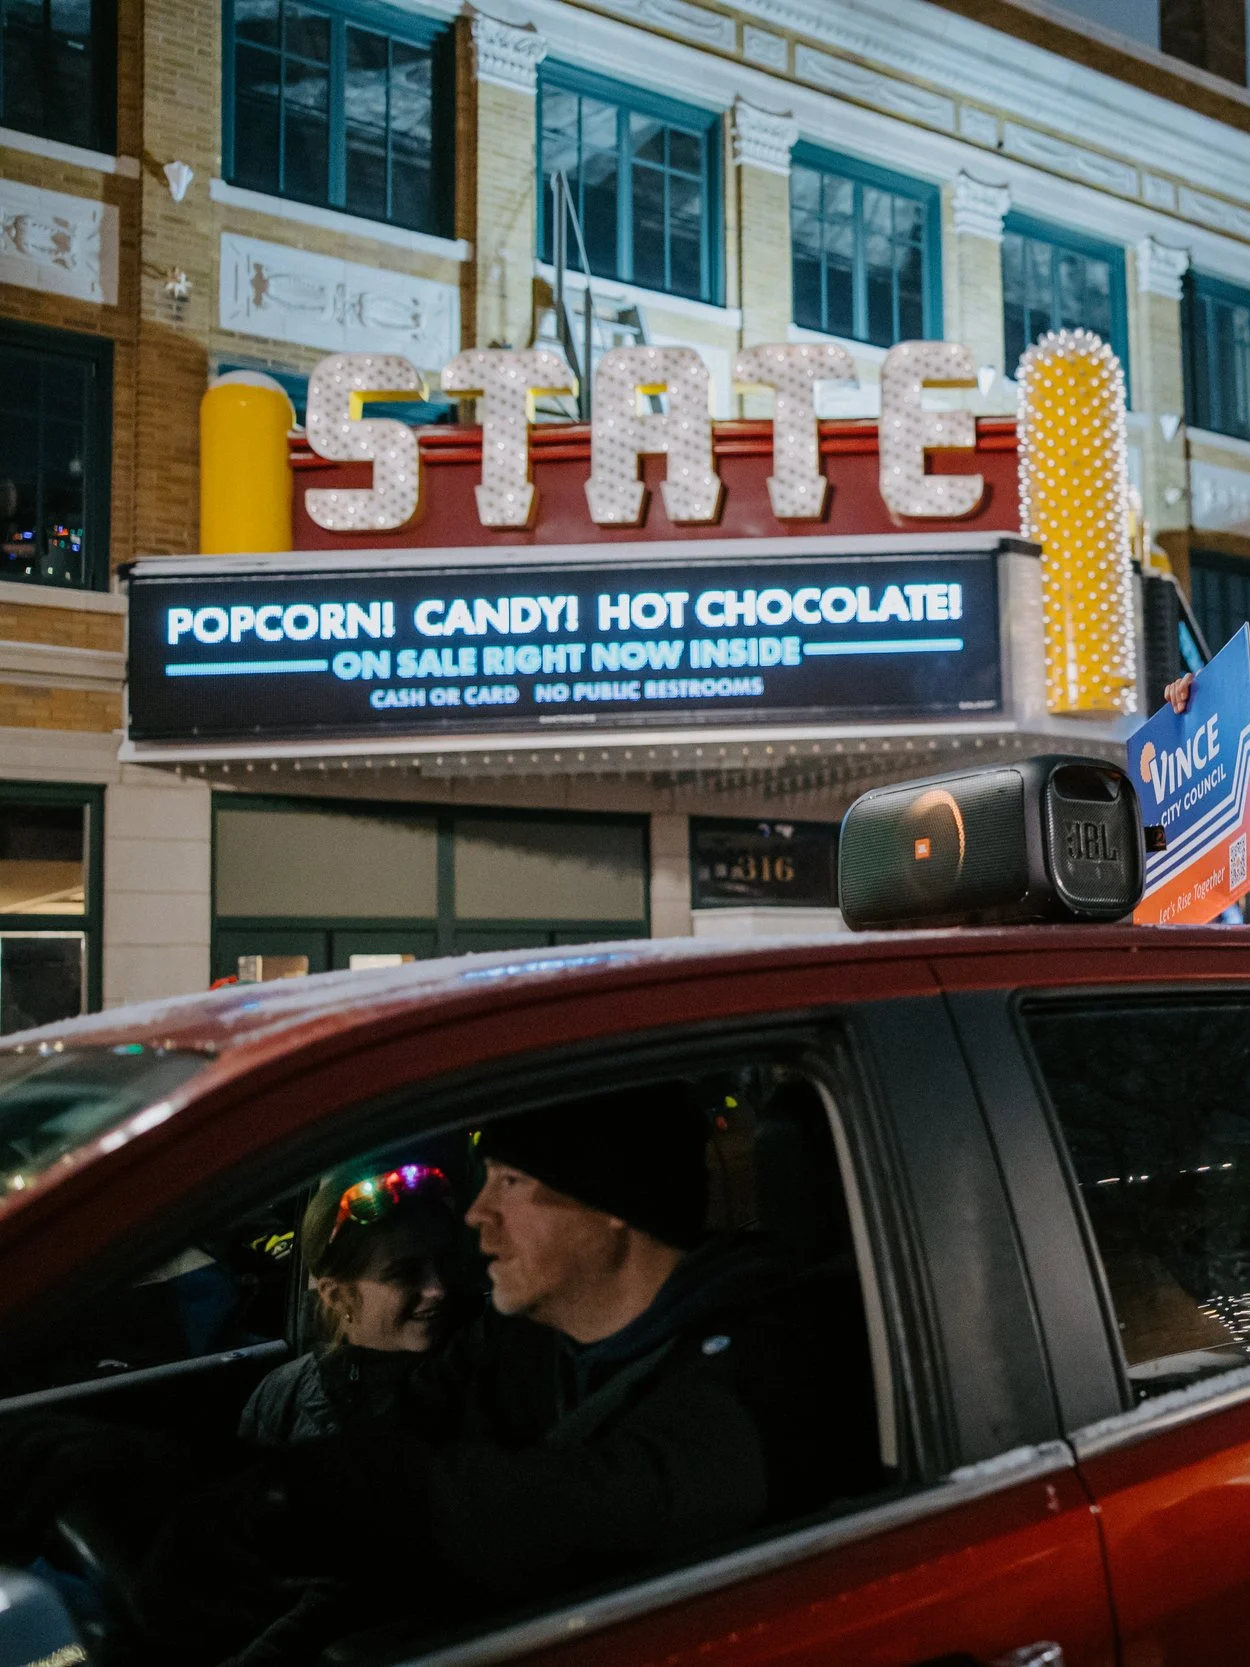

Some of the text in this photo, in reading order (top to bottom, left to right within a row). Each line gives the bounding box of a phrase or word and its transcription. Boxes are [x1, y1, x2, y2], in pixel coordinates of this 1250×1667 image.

[304, 340, 985, 531] STATE
[167, 583, 962, 645] POPCORN! CANDY! HOT CHOCOLATE!
[332, 636, 801, 681] ON SALE RIGHT NOW INSIDE
[370, 676, 765, 709] CASH OR CARD NO PUBLIC RESTROOMS
[1150, 713, 1220, 805] VINCE
[1161, 763, 1227, 828] CITY COUNCIL
[738, 856, 795, 881] 316
[1066, 821, 1118, 861] JBL
[1159, 901, 1175, 924] Let's
[1177, 892, 1192, 913] Rise
[1194, 866, 1225, 902] Together
